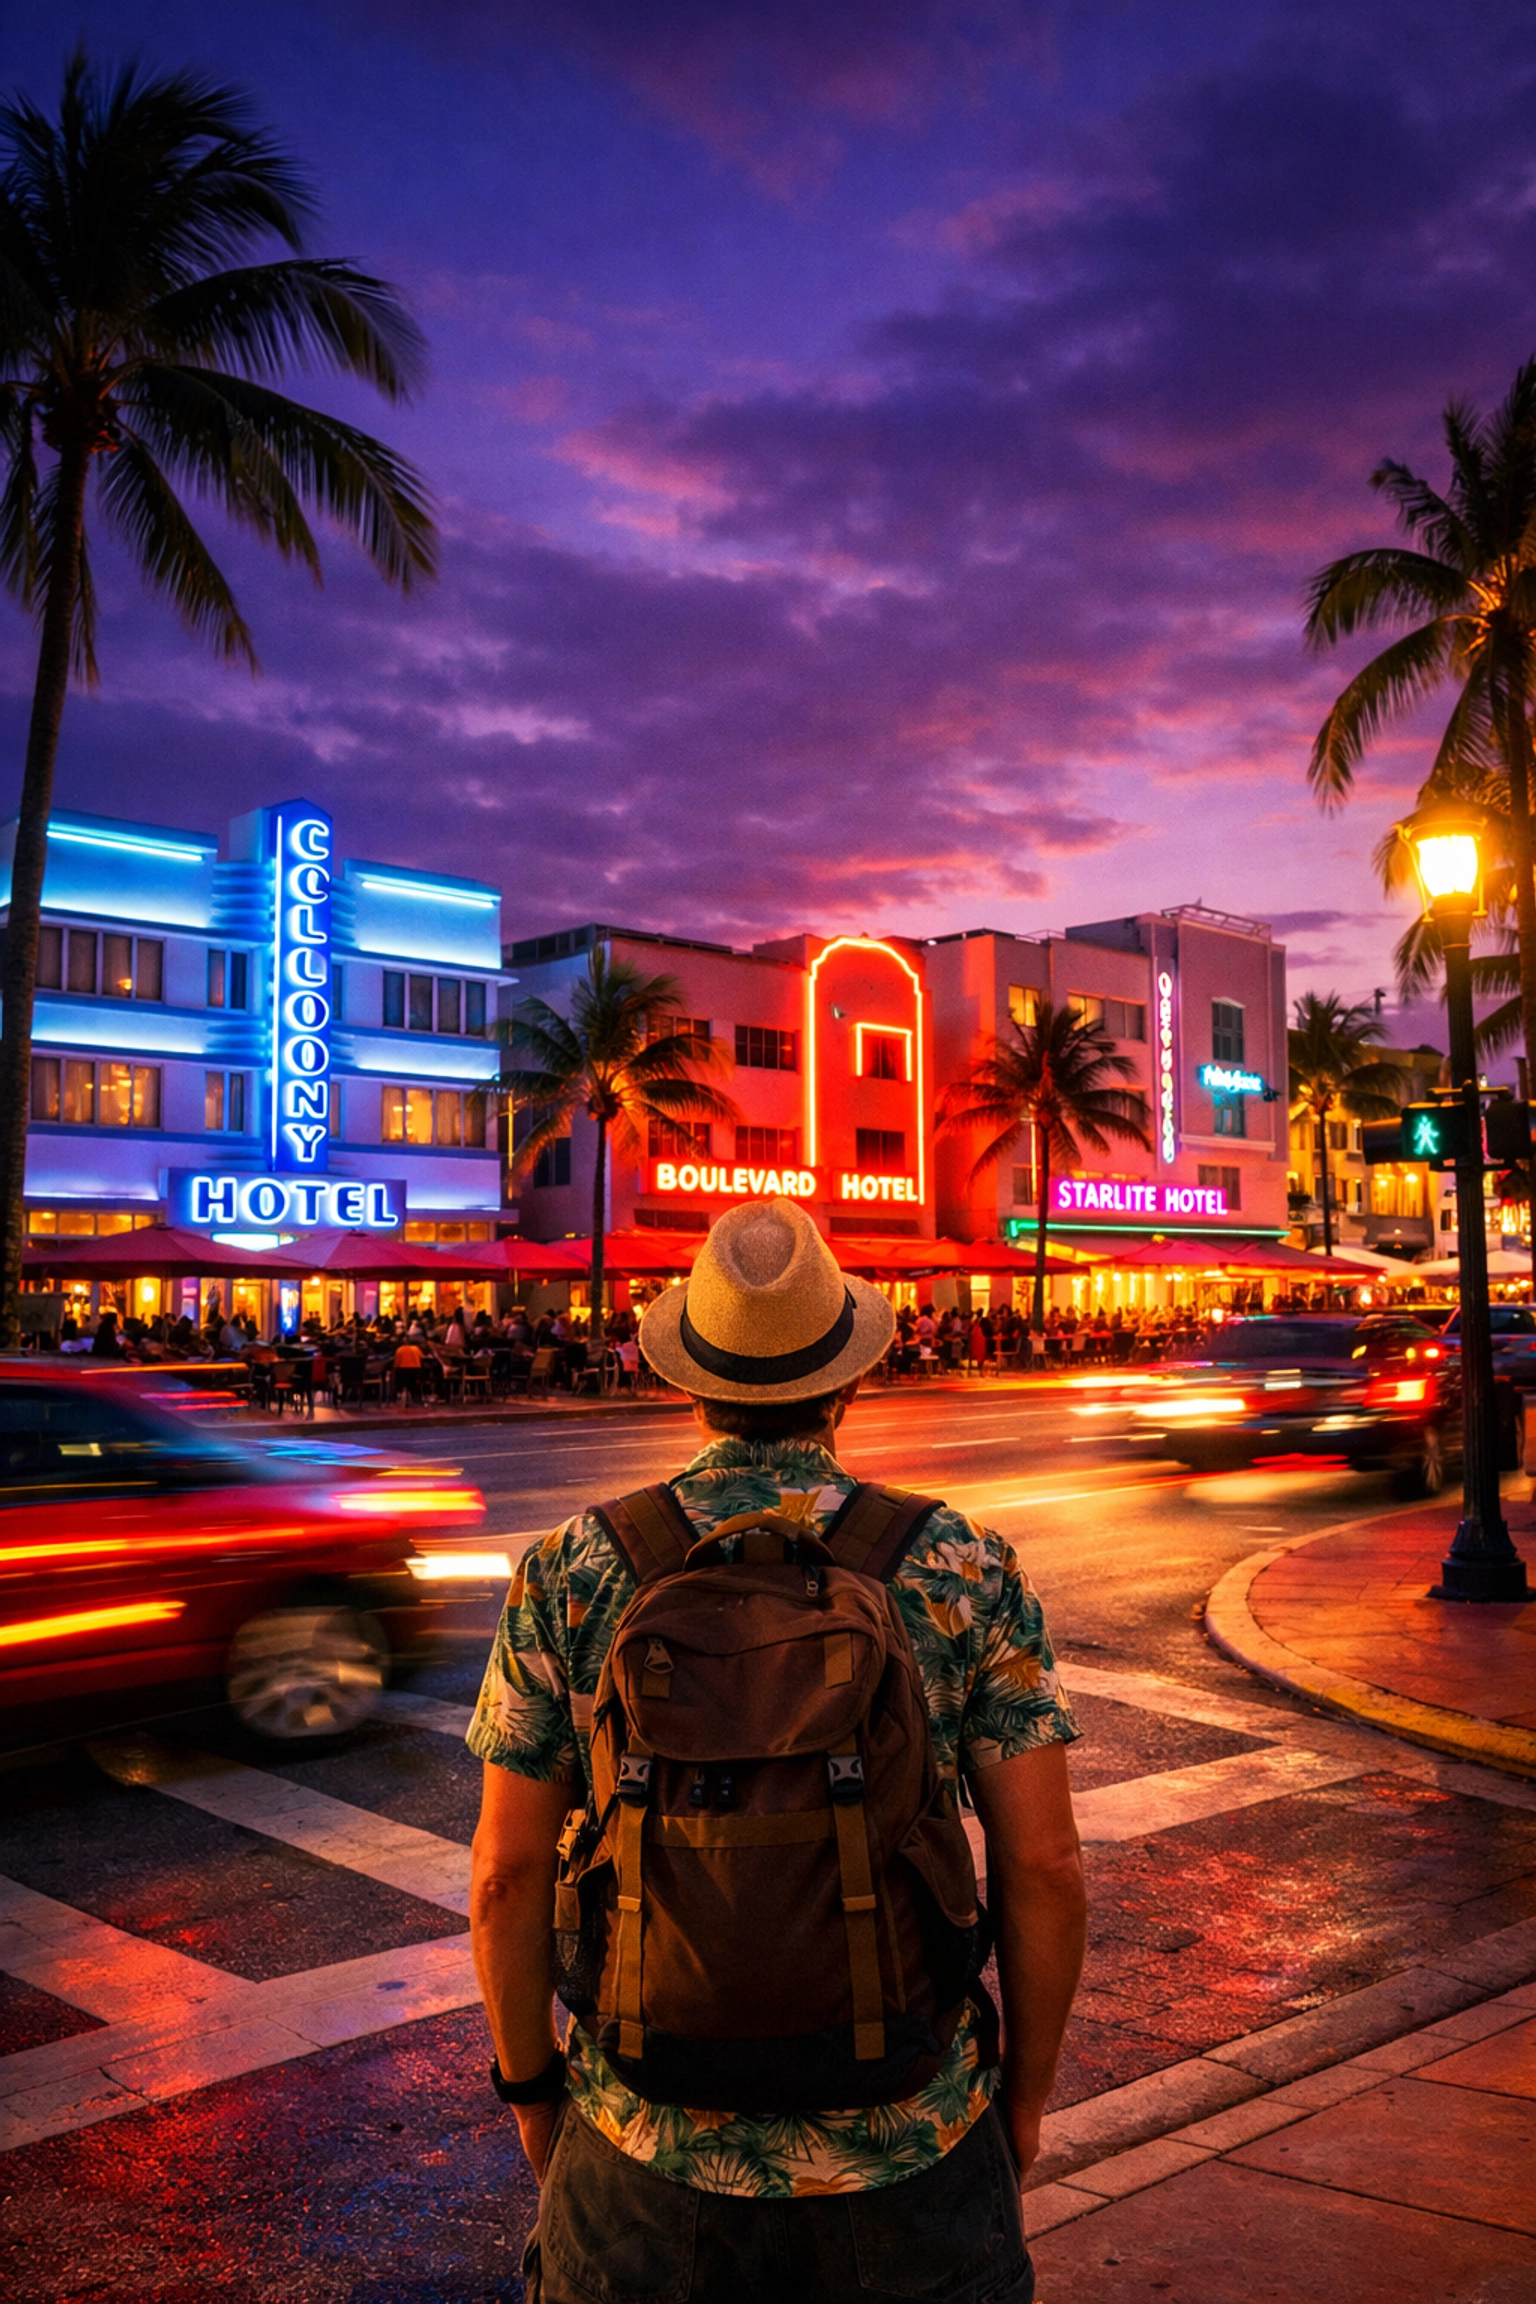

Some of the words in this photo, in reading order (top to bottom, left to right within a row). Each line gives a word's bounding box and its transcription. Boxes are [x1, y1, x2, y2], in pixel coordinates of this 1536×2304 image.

[191, 1175, 399, 1227] HOTEL
[656, 1162, 817, 1197] BOULEVARD
[841, 1173, 919, 1202] HOTEL
[1057, 1180, 1157, 1212] STARLITE
[1165, 1187, 1228, 1216] HOTEL
